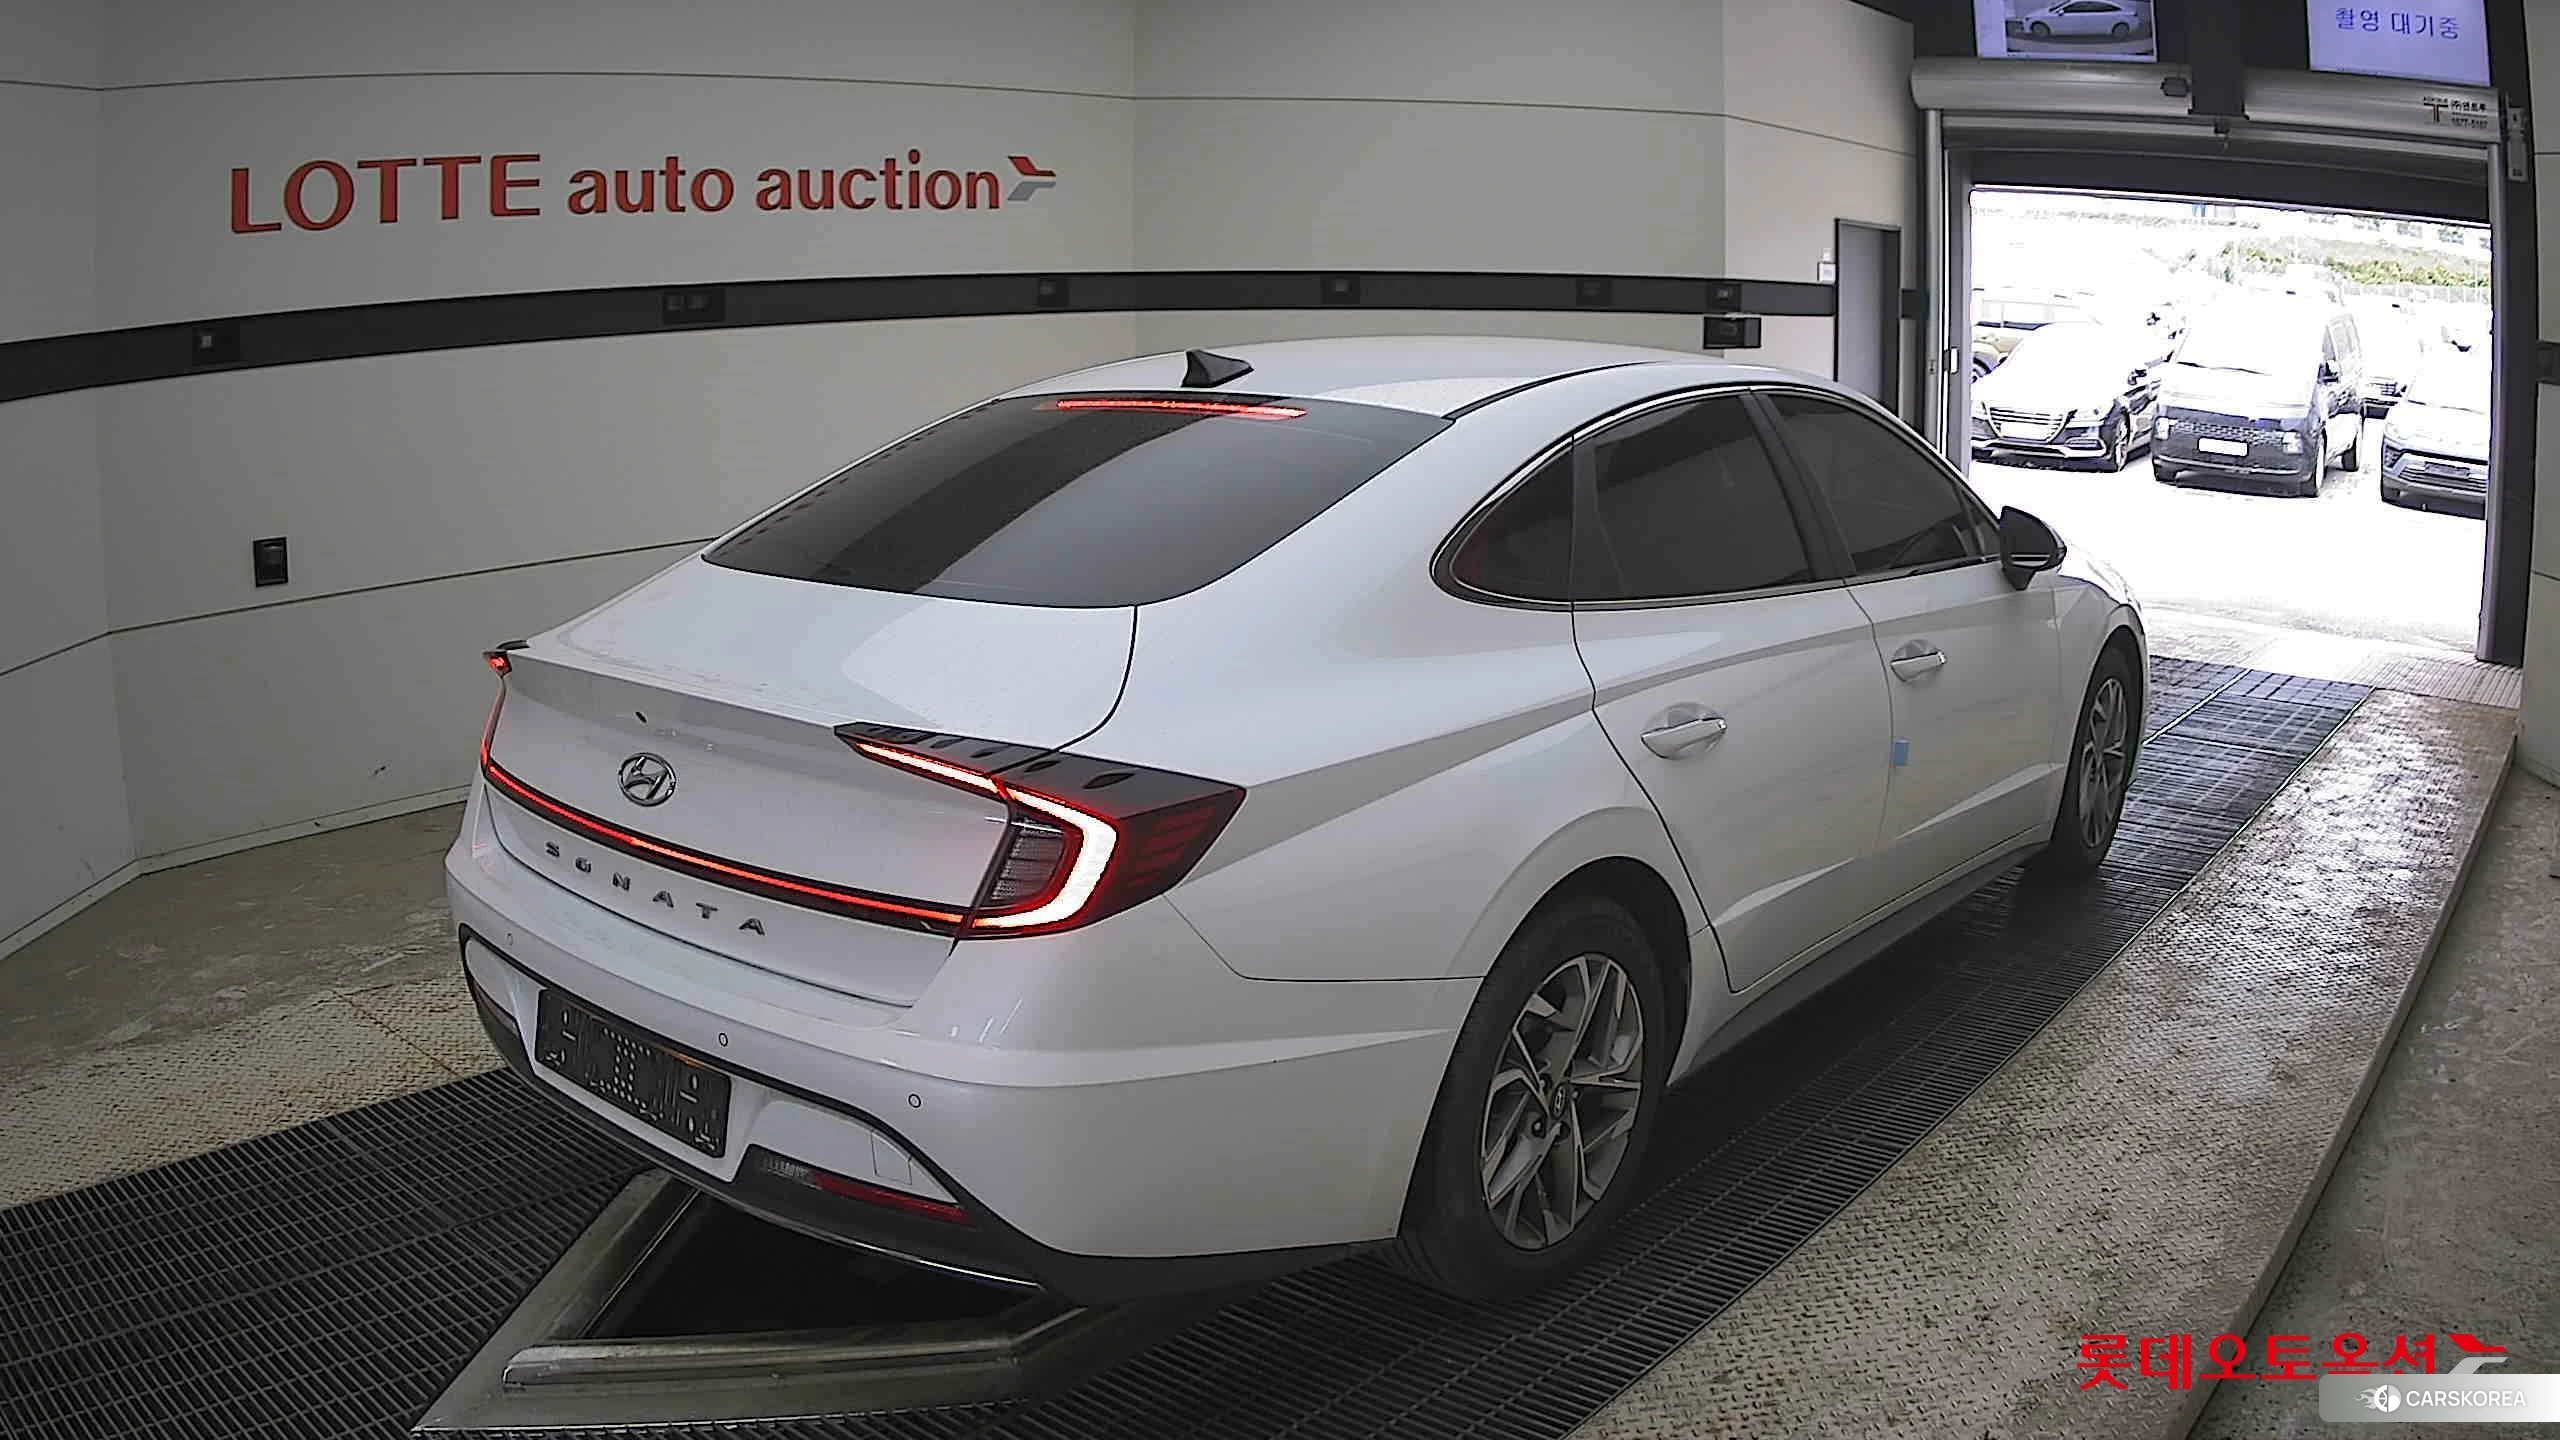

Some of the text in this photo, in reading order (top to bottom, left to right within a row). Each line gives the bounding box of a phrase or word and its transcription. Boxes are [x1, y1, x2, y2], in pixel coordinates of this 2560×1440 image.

[2335, 7, 2461, 40] 촬영 대기중
[232, 149, 1002, 234] LOTTE auto auction
[545, 841, 766, 936] SONATA
